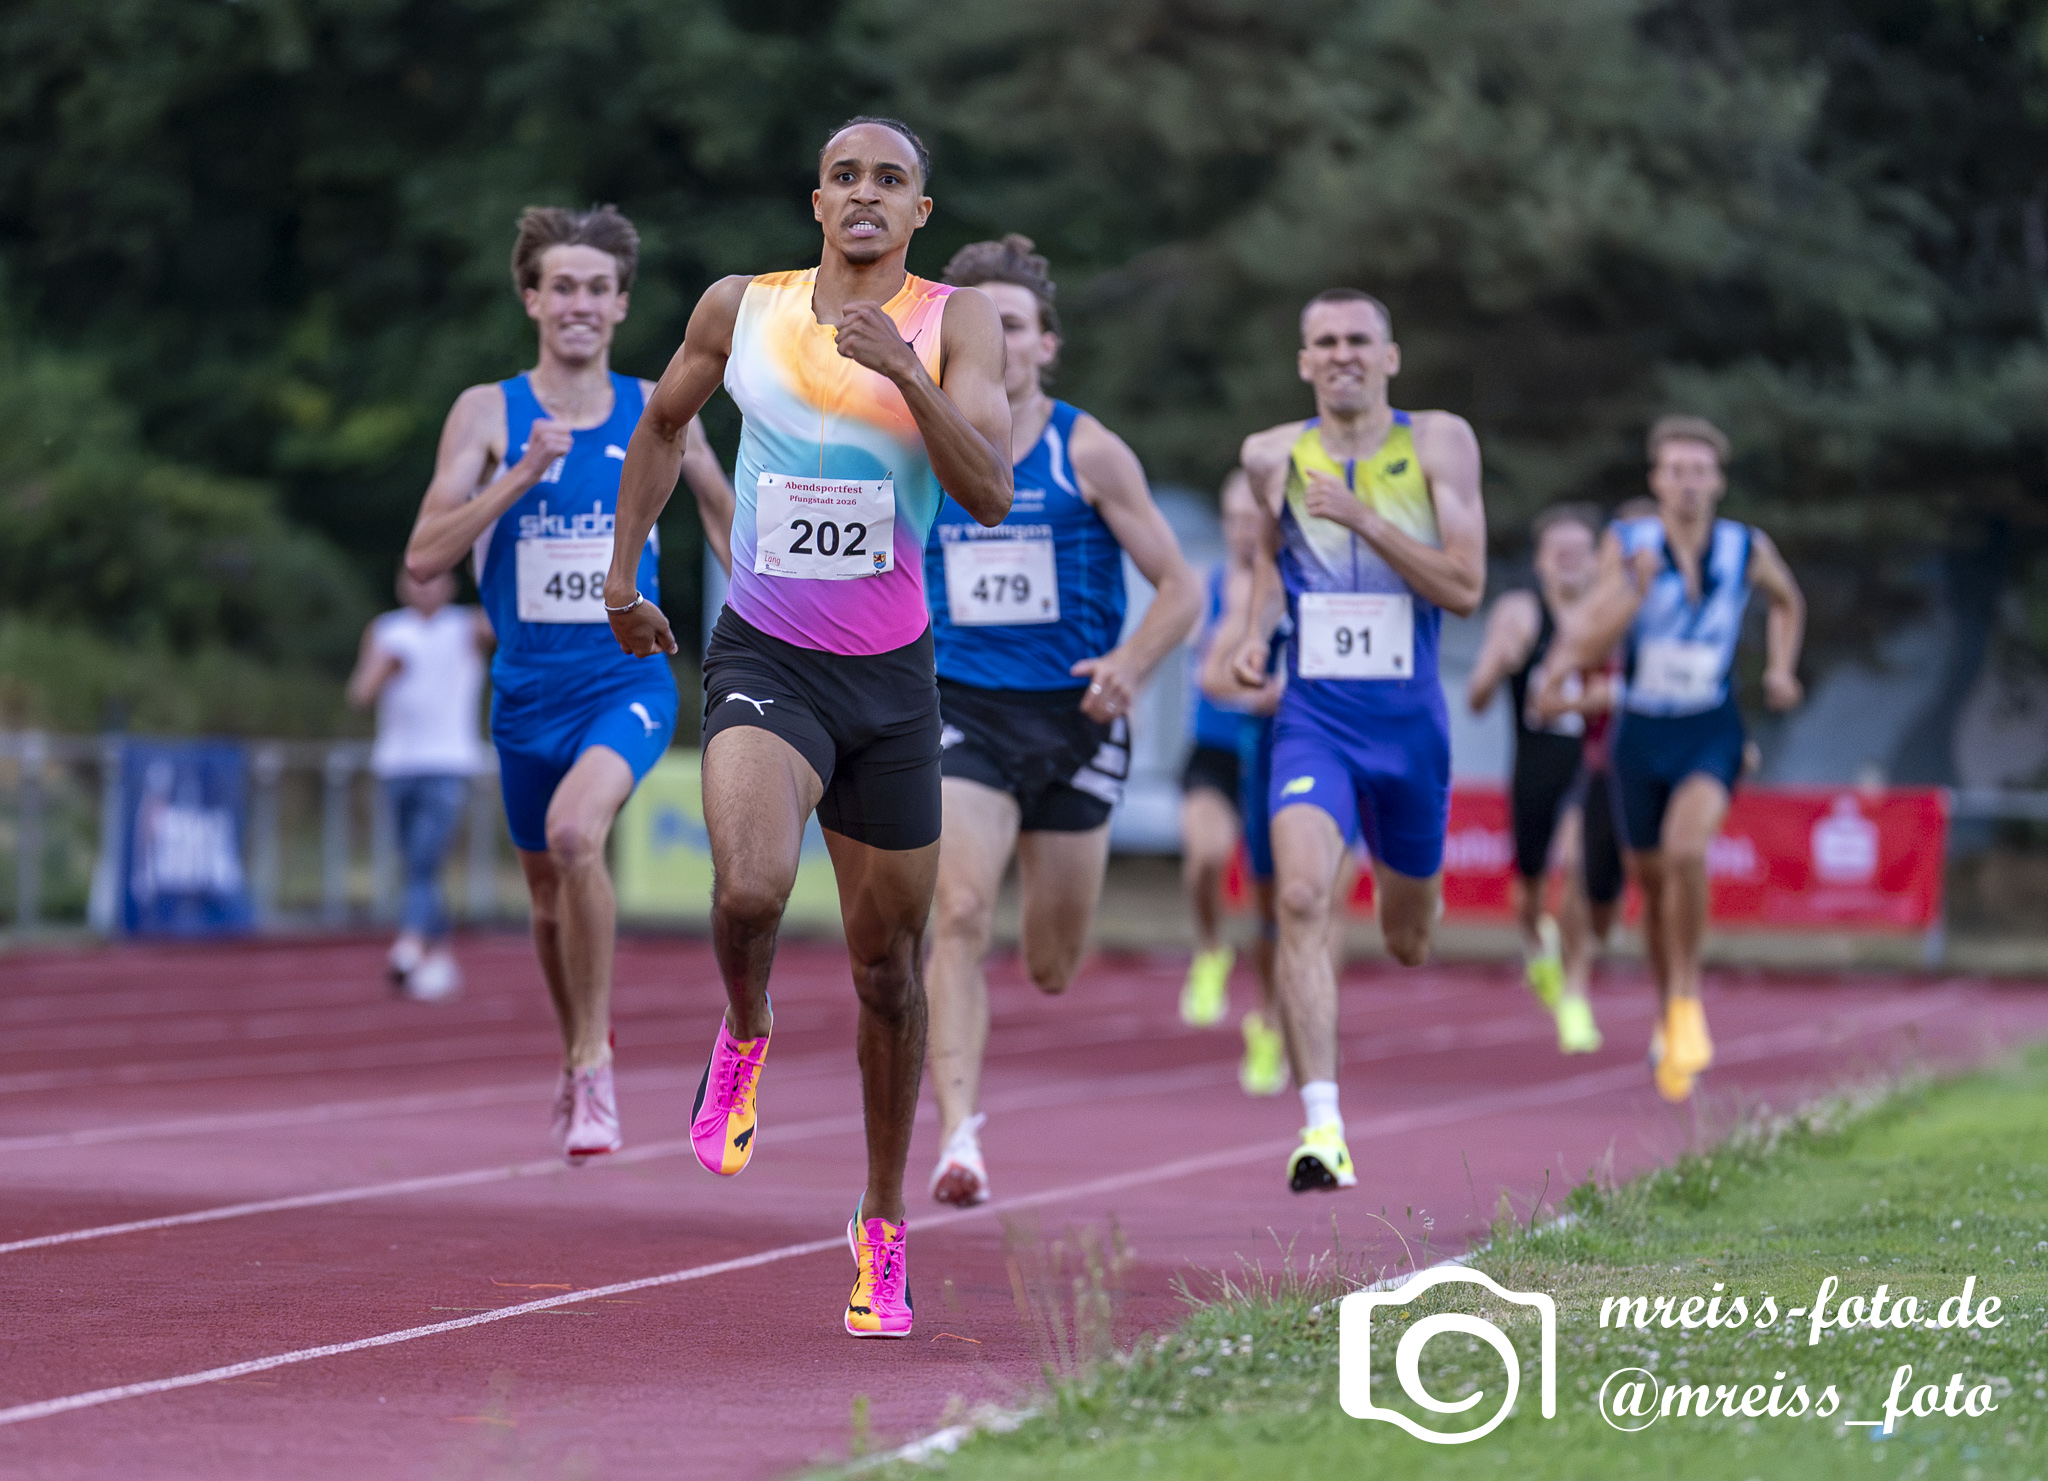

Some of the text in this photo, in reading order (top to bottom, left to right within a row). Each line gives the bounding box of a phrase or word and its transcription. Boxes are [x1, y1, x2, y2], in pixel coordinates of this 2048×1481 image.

[784, 481, 863, 495] Abendsportfest
[789, 494, 857, 506] Pfungstadt 2026
[788, 519, 867, 556] 202
[544, 571, 606, 601] 498
[972, 573, 1030, 604] 479
[1335, 626, 1372, 656] 91
